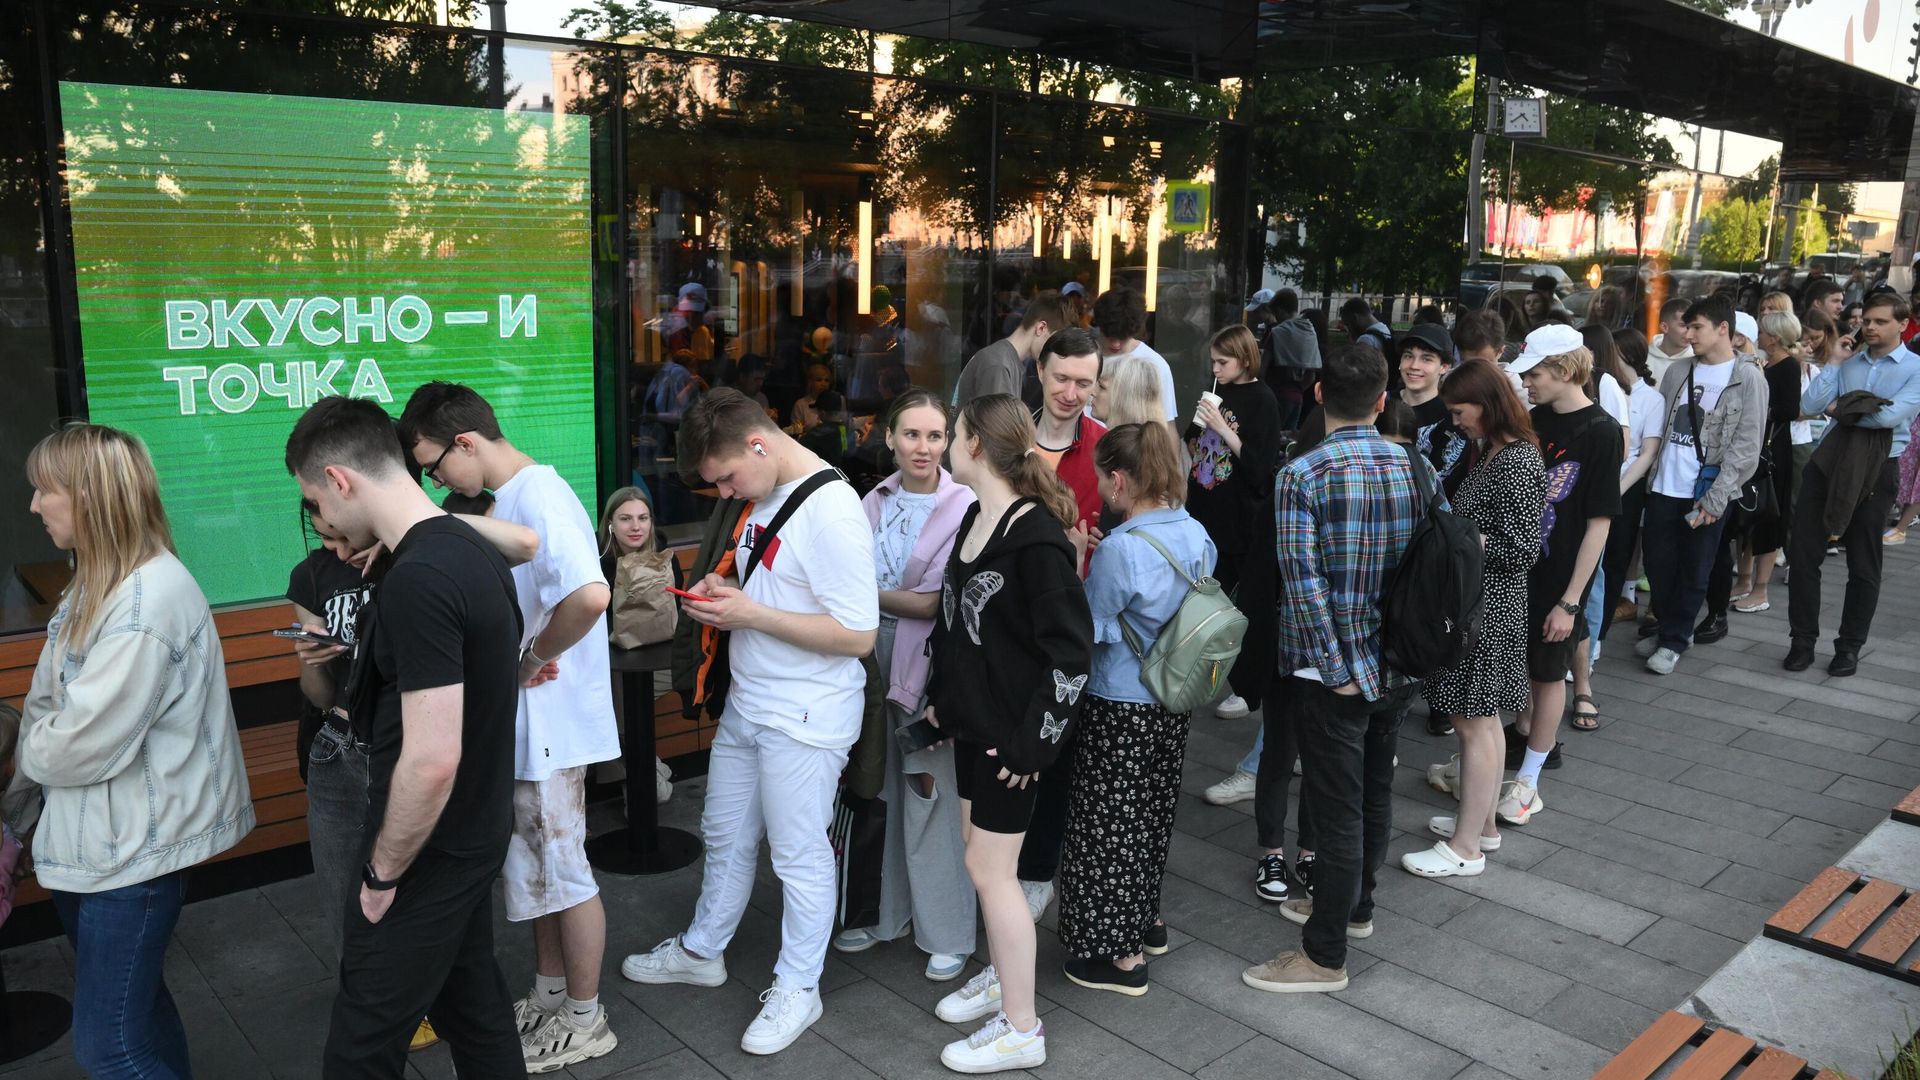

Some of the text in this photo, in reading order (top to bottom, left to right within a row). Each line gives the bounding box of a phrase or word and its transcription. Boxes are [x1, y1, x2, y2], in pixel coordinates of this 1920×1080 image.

[165, 295, 432, 350] ВКУСНО
[499, 294, 537, 338] И
[163, 358, 394, 415] ТОЧКА
